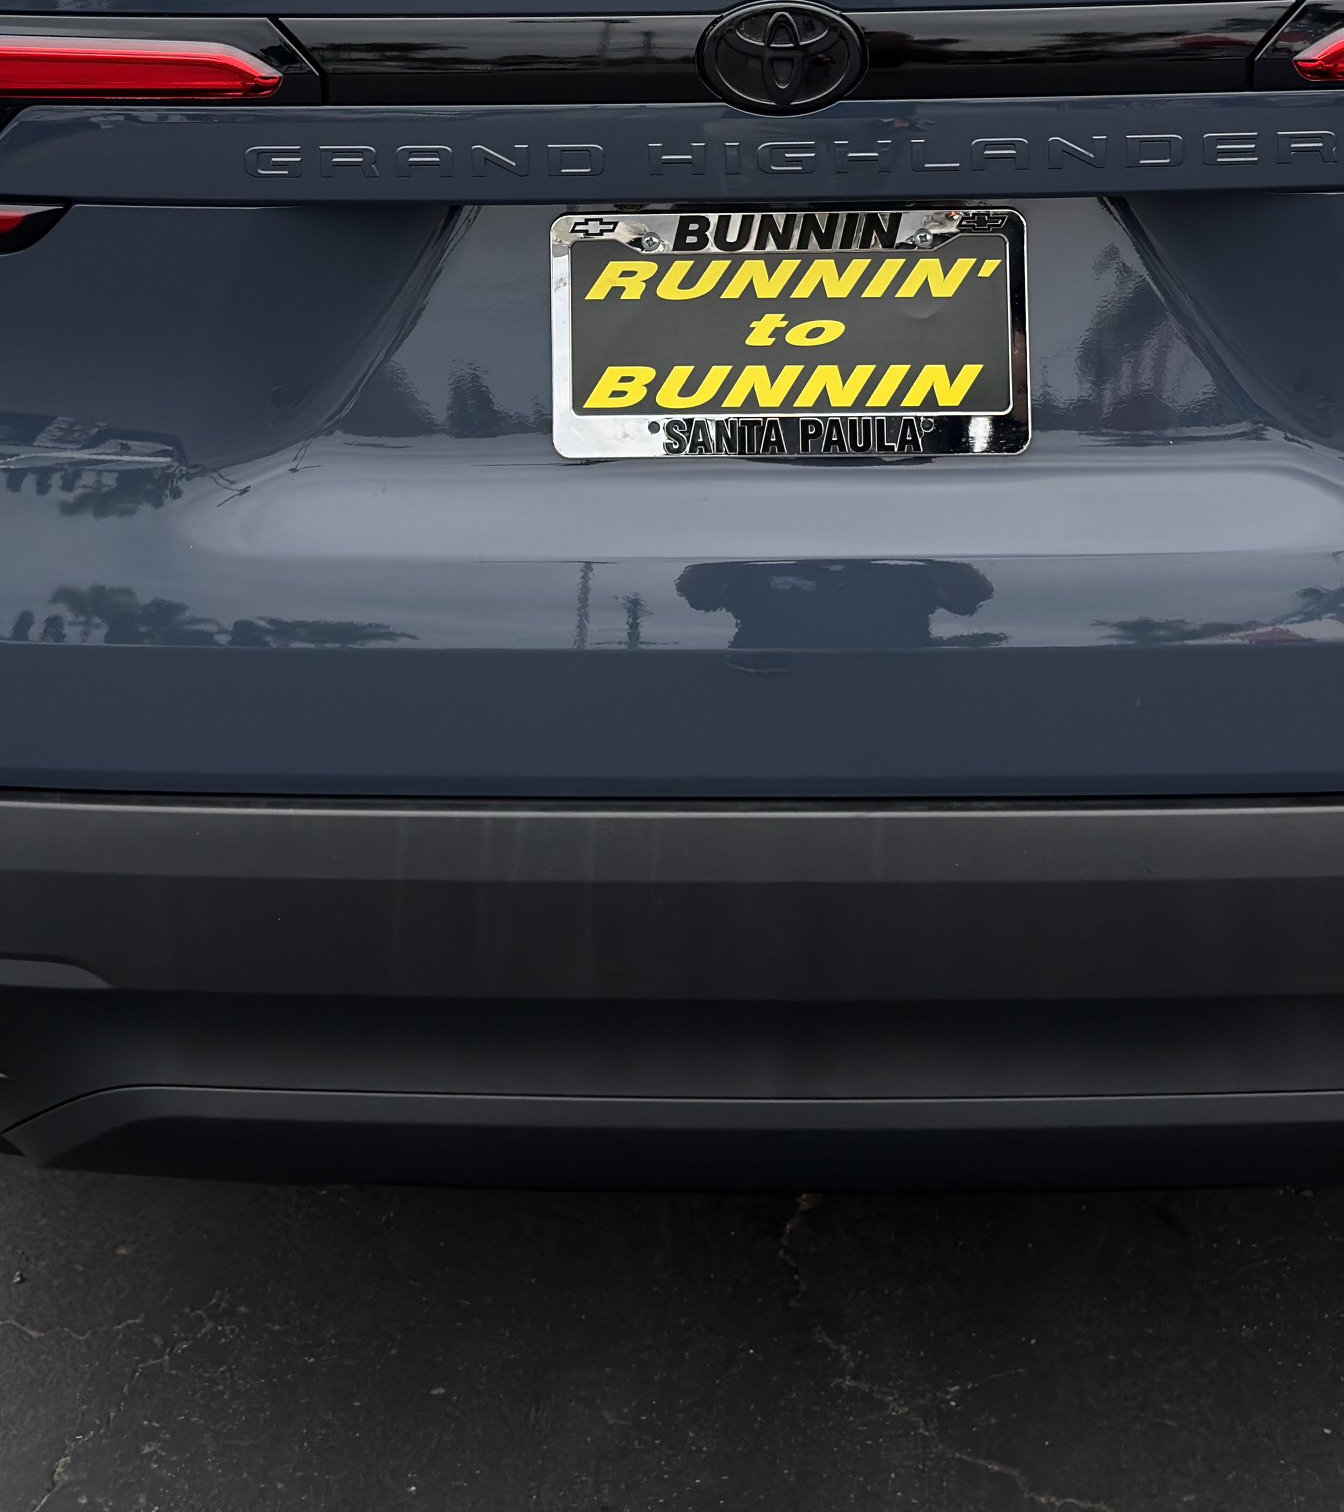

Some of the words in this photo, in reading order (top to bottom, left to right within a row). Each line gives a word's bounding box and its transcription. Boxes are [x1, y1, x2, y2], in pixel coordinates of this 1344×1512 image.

[244, 144, 604, 178] GRAND
[648, 131, 1339, 176] HIGHLANDER
[673, 212, 903, 252] BUNNIN
[584, 258, 1002, 301] RUNNIN'
[744, 313, 846, 347] to
[583, 364, 984, 409] BUNNIN
[663, 418, 785, 455] SANTA
[800, 417, 923, 454] PAULA
